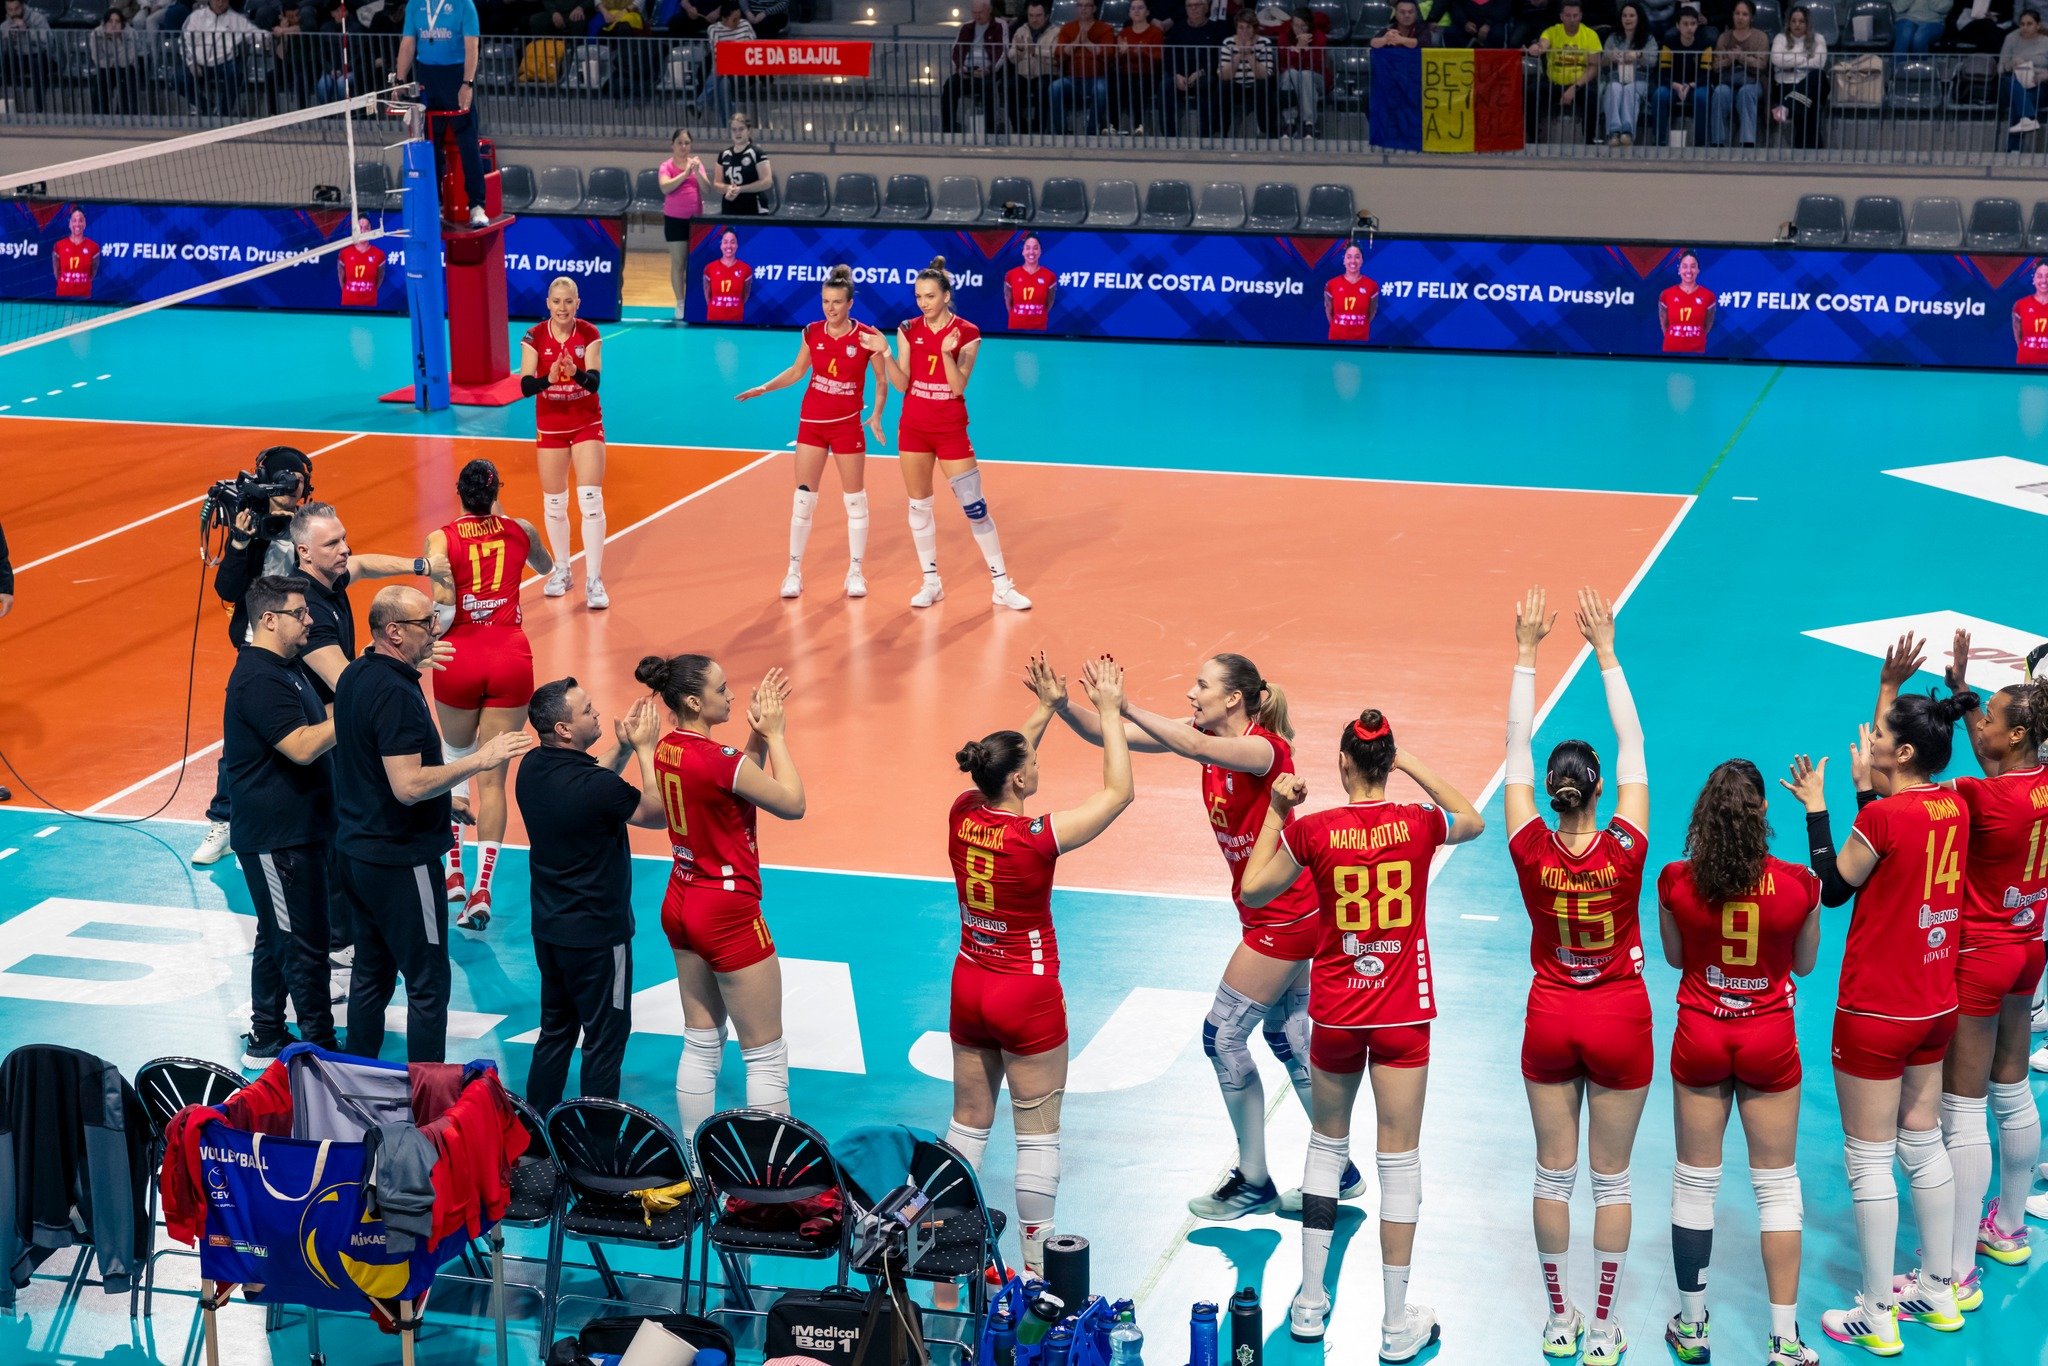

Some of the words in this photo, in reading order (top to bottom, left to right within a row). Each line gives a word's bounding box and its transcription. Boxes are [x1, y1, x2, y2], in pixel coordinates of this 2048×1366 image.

[745, 47, 764, 65] CE
[788, 47, 841, 65] BLAJUL
[725, 166, 744, 185] 15
[101, 242, 130, 258] #17
[133, 242, 177, 260] FELIX
[181, 244, 242, 262] COSTA
[388, 250, 405, 266] #1
[69, 256, 80, 270] 17
[354, 264, 366, 278] 17
[536, 254, 612, 277] Drussyla
[721, 279, 732, 293] 17
[754, 264, 784, 281] #17
[788, 265, 832, 283] FELIX
[852, 266, 901, 284] OSTA
[906, 269, 983, 290] Dsyla
[1058, 271, 1090, 288] #17
[1094, 272, 1143, 290] FELIX
[1147, 273, 1216, 292] COSTA
[1222, 275, 1304, 299] Drussyla
[1022, 287, 1034, 300] 17
[1344, 297, 1356, 310] 17
[1381, 281, 1414, 298] #17
[1417, 282, 1468, 300] FELIX
[1473, 283, 1544, 302] COSTA
[1549, 285, 1635, 309] Drussyla
[1679, 307, 1692, 322] 17
[1718, 291, 1752, 309] #17
[1757, 292, 1811, 311] FELIX
[1815, 293, 1890, 313] COSTA
[1895, 295, 1986, 320] Drussyla
[2034, 317, 2047, 333] 17
[827, 357, 838, 377] 4
[927, 354, 938, 376] 7
[468, 539, 506, 593] 17
[655, 768, 688, 836] 10
[1923, 798, 1960, 822] ROMAN
[1329, 828, 1368, 850] MARIA
[1370, 820, 1411, 850] ROTAR
[1923, 825, 1961, 900] 14
[966, 845, 995, 912] 8
[1333, 860, 1413, 931] 88
[970, 916, 1007, 932] PRENIS
[1552, 891, 1615, 949] 15
[1929, 908, 1958, 925] PRENIS
[1721, 902, 1760, 967] 9
[1357, 940, 1402, 954] PRENIS
[1723, 977, 1768, 990] PRENIS
[199, 1145, 269, 1170] VOLLEYBALL
[211, 1191, 230, 1200] CEV
[795, 1325, 860, 1339] Medical
[795, 1335, 835, 1351] Bag
[838, 1338, 851, 1353] 1
